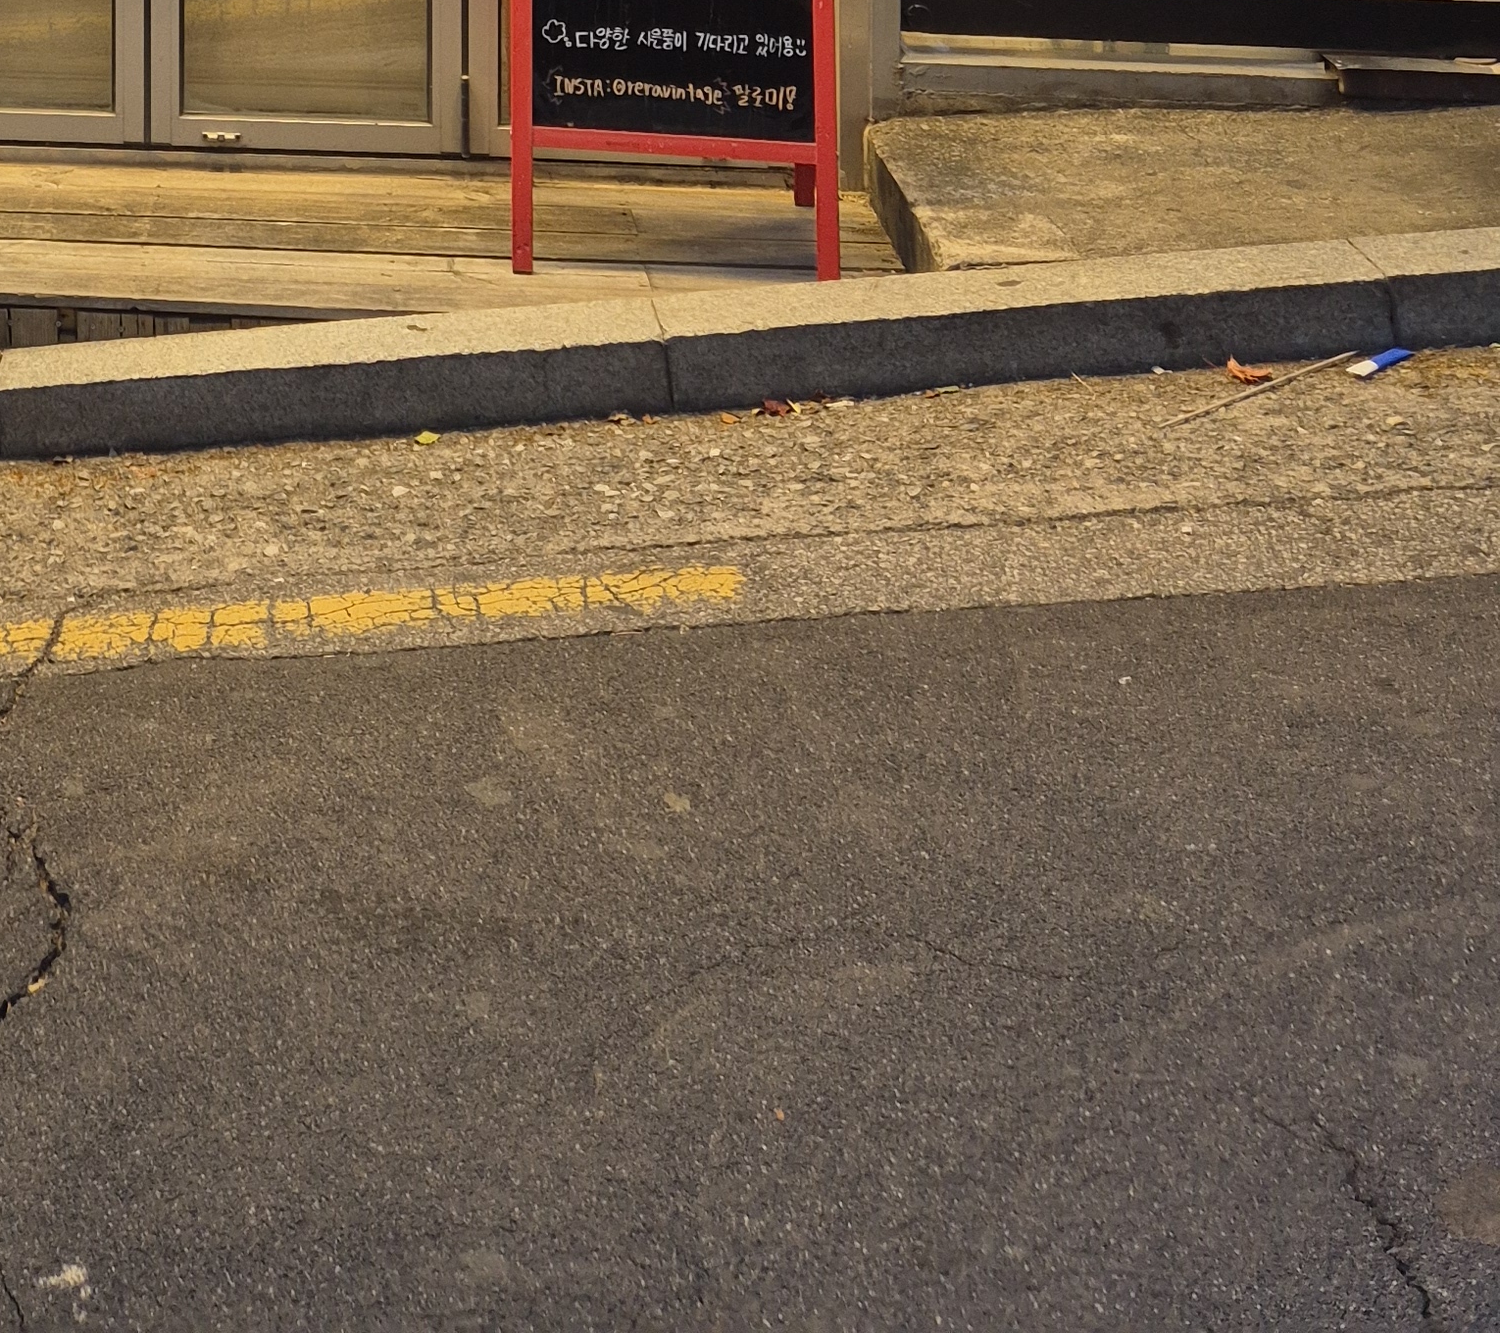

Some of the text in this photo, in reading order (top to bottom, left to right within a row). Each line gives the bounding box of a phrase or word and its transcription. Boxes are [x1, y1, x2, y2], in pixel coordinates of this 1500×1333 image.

[575, 26, 630, 50] 다양한
[637, 27, 687, 52] 사은품이
[696, 31, 749, 55] 기다리고
